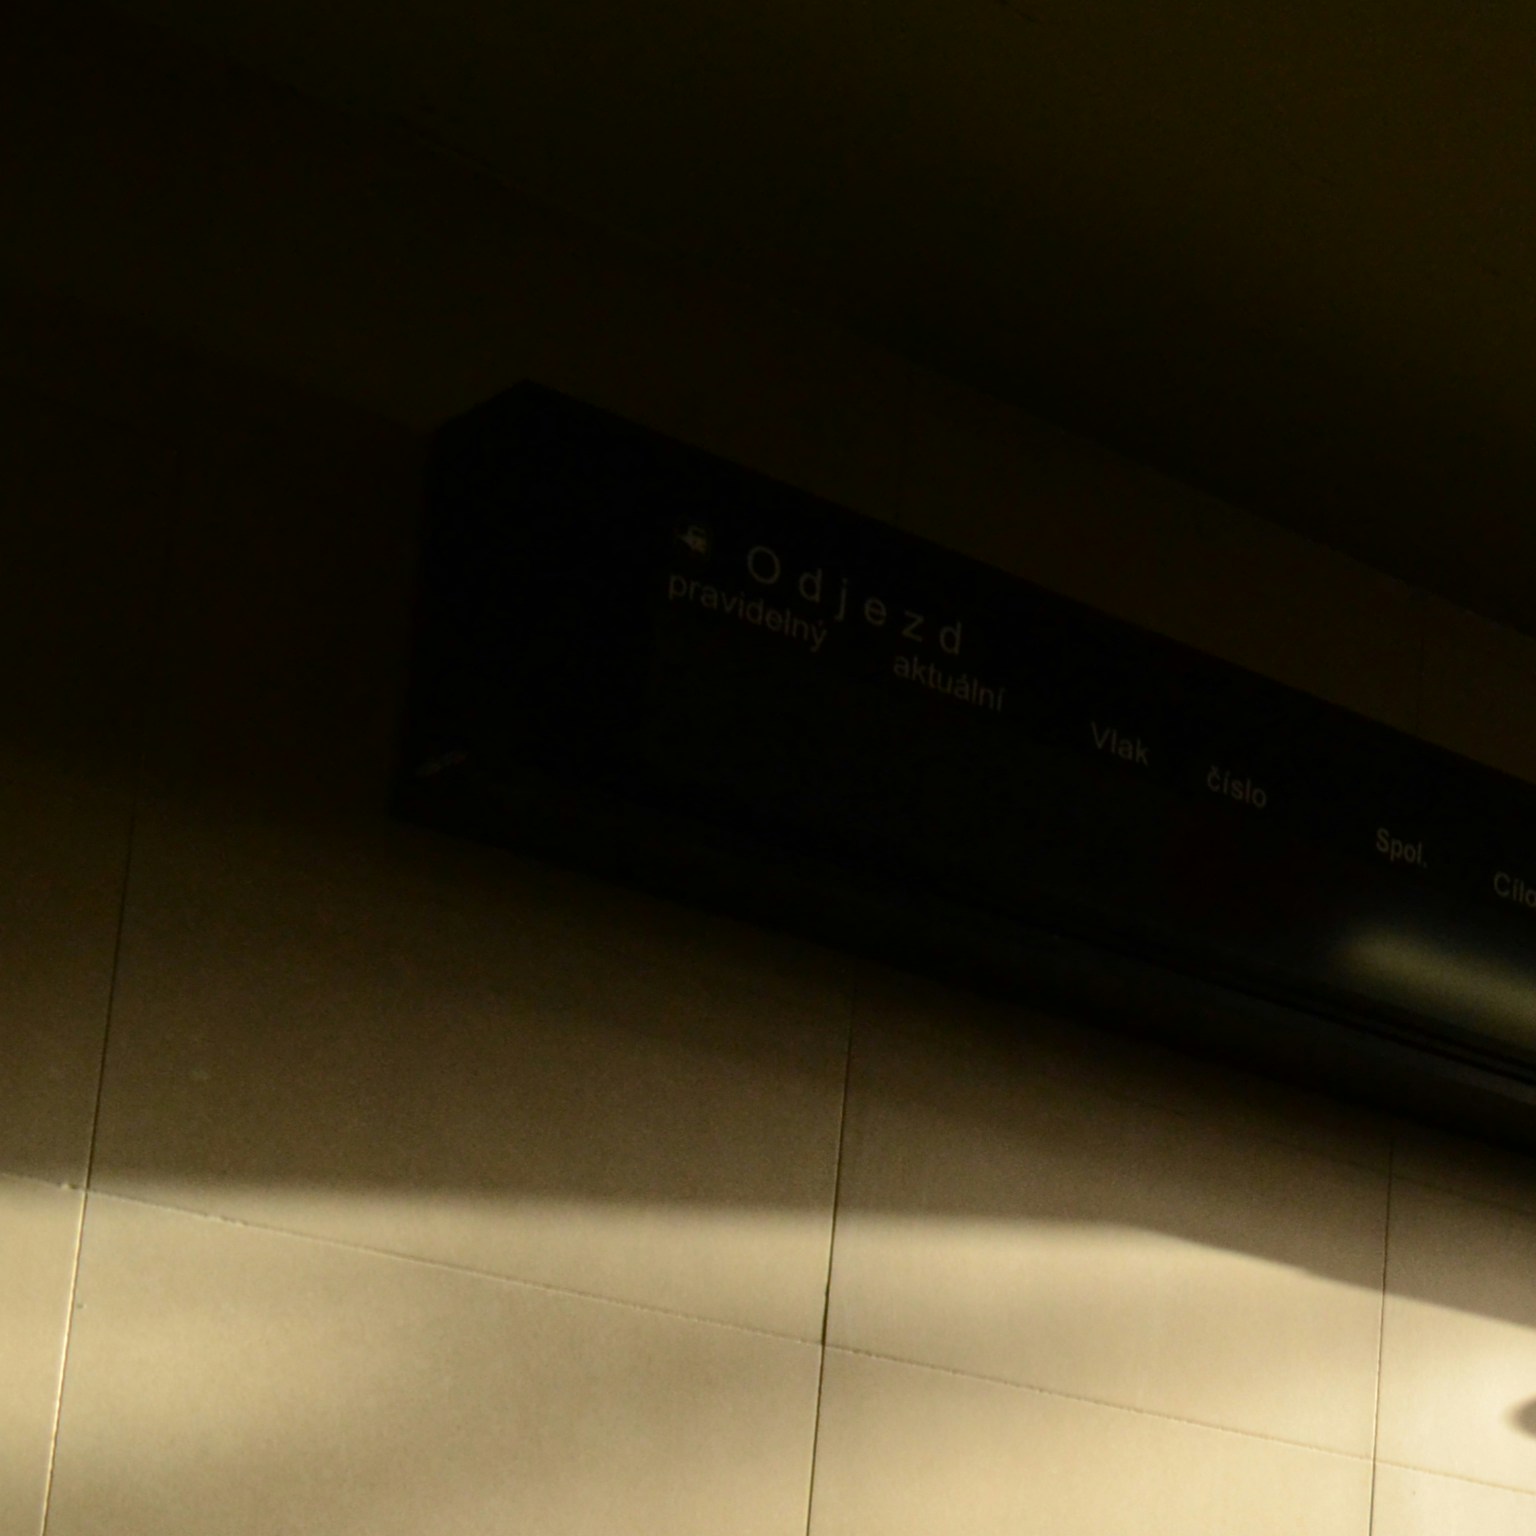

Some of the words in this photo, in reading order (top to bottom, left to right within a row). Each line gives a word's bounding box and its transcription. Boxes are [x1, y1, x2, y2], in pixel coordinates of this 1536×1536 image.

[666, 571, 829, 654] pravidelný
[891, 652, 1008, 713] aktuální
[745, 544, 964, 657] Odjezd
[1089, 720, 1153, 767] Vlak
[1204, 764, 1269, 809] číslo
[1374, 826, 1430, 870] Spol.
